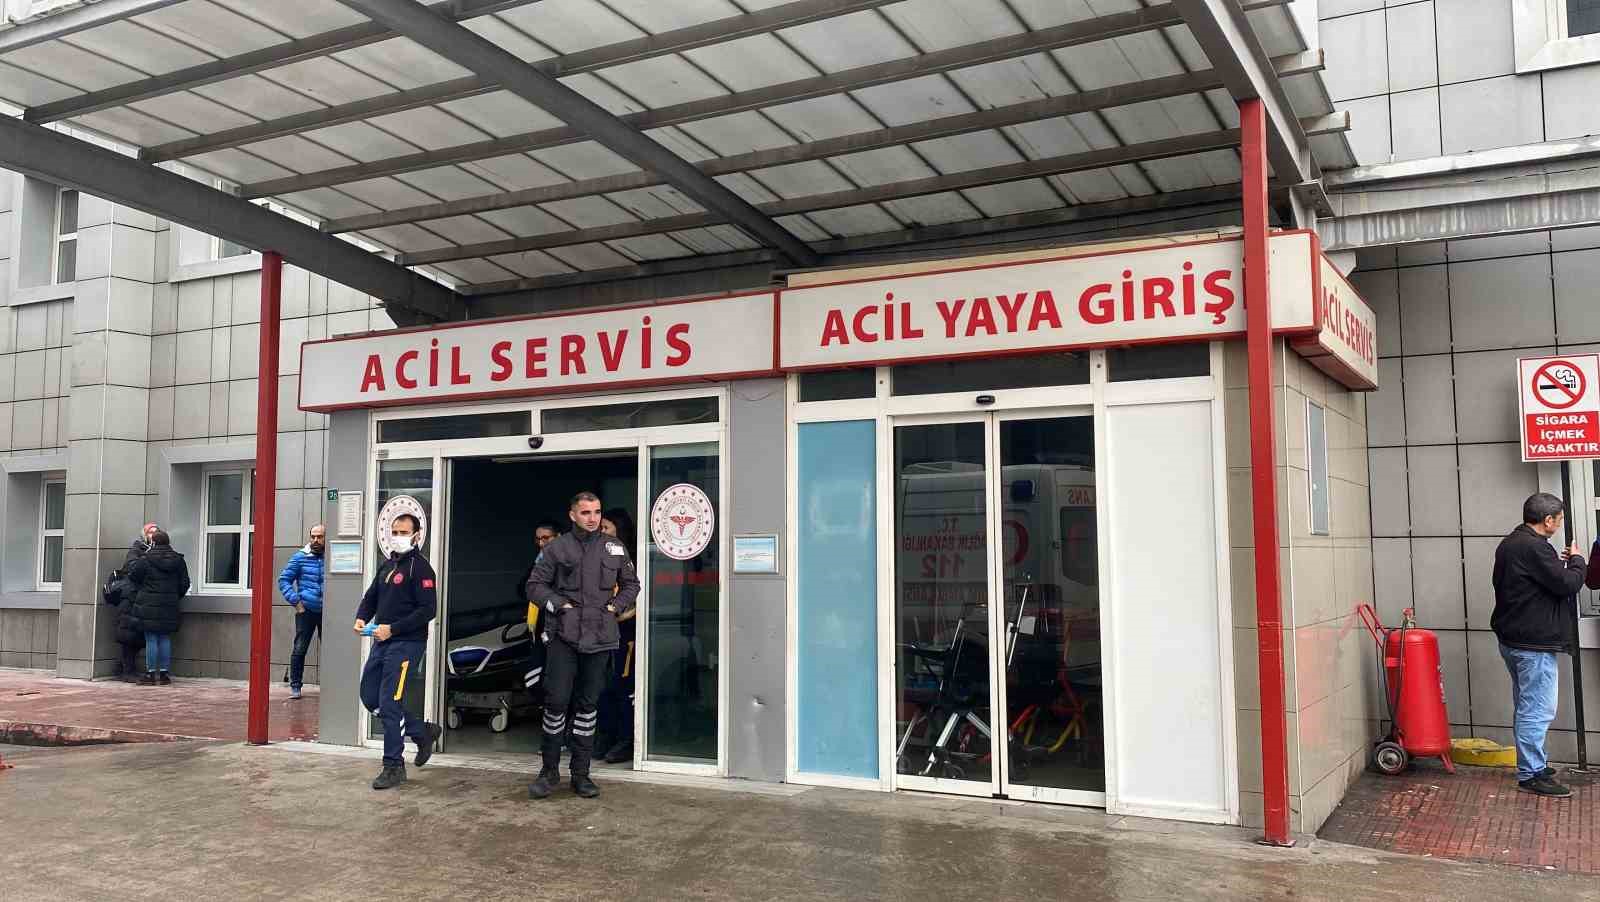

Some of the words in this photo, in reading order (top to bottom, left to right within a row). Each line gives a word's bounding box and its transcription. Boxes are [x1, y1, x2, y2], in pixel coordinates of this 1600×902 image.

[821, 291, 925, 349] ACİL
[936, 288, 1063, 340] YAYA
[1078, 256, 1247, 327] GİRİŞ
[1322, 286, 1345, 341] ACİL
[1345, 308, 1373, 367] SERVİS
[361, 338, 472, 393] ACİL
[489, 314, 693, 383] SERVİS
[1535, 414, 1588, 426] SİGARA
[1540, 429, 1586, 441] İÇMEK
[1528, 442, 1599, 454] YASAKTIR
